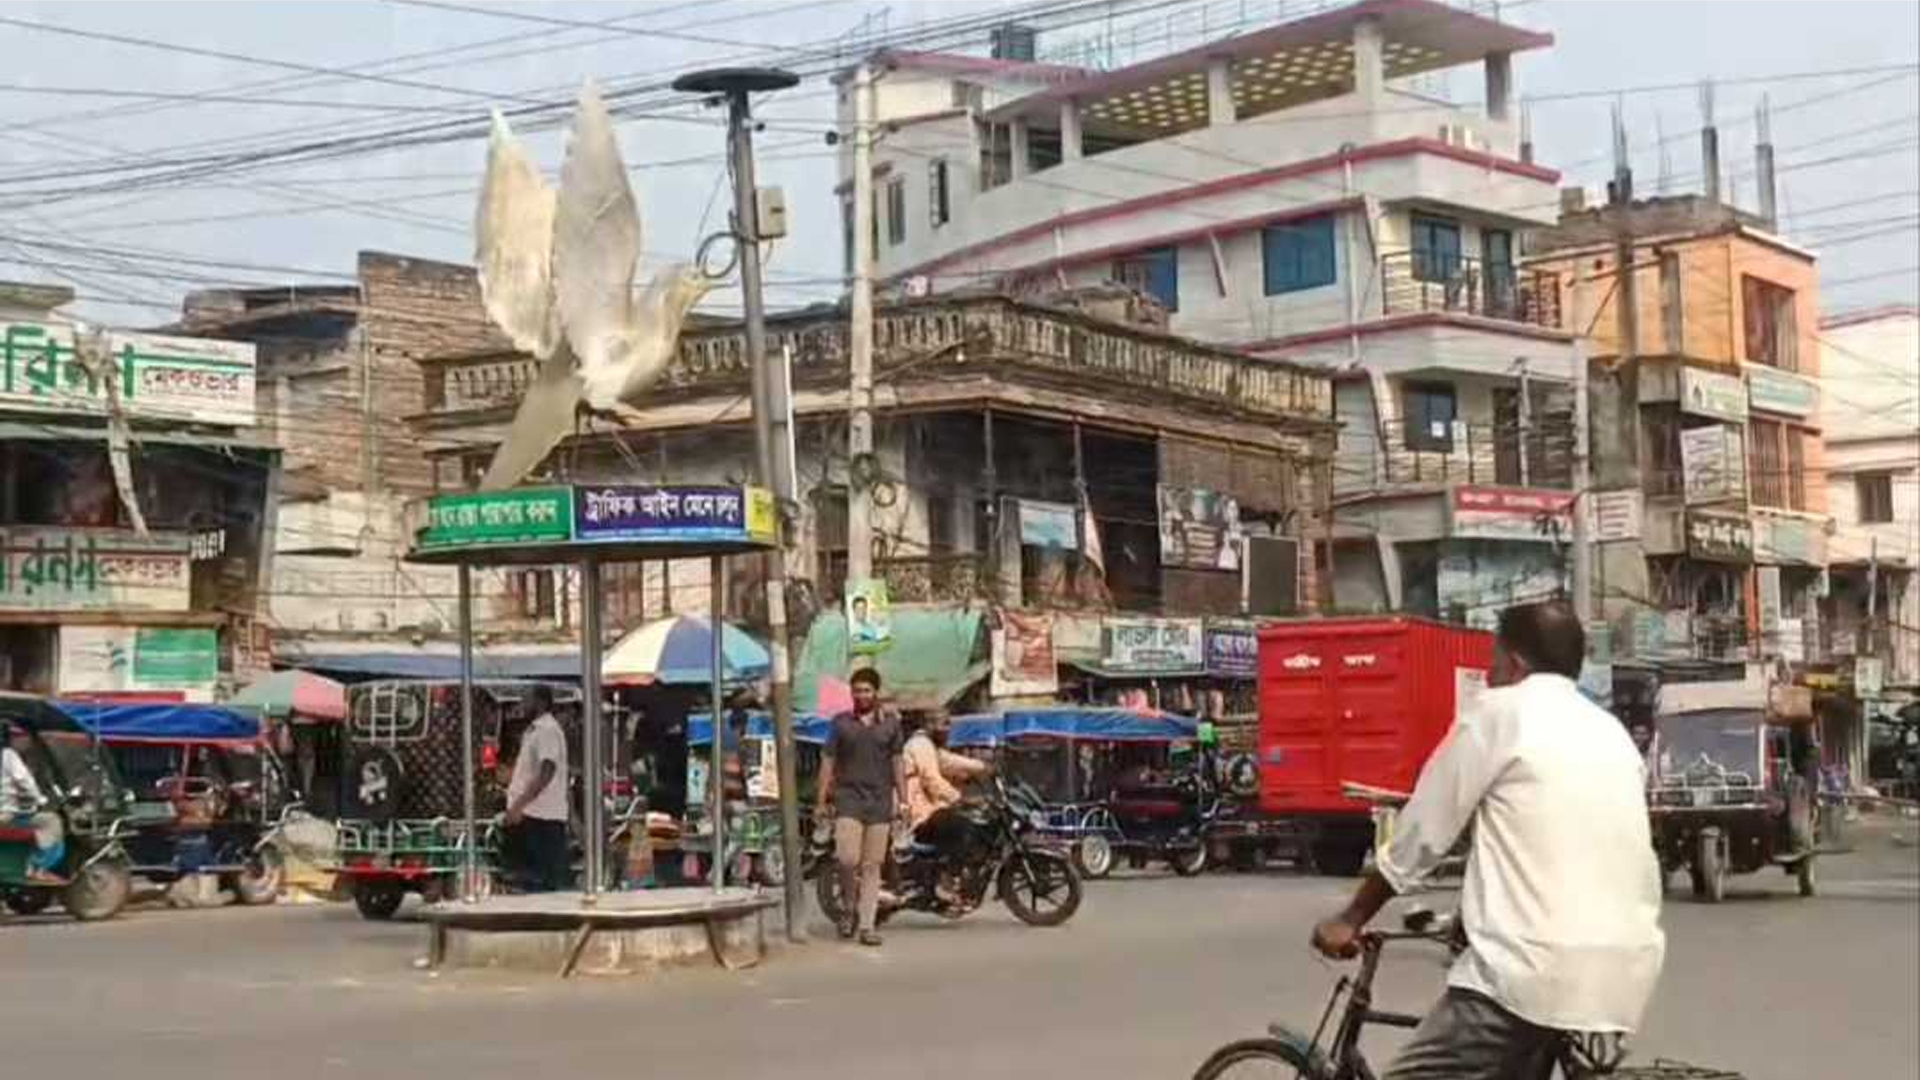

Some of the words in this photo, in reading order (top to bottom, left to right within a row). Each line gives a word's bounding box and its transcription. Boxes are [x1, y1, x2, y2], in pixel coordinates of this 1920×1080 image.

[585, 490, 635, 522] ট্রাফিক
[640, 490, 679, 520] আইন
[684, 494, 714, 517] মেনে
